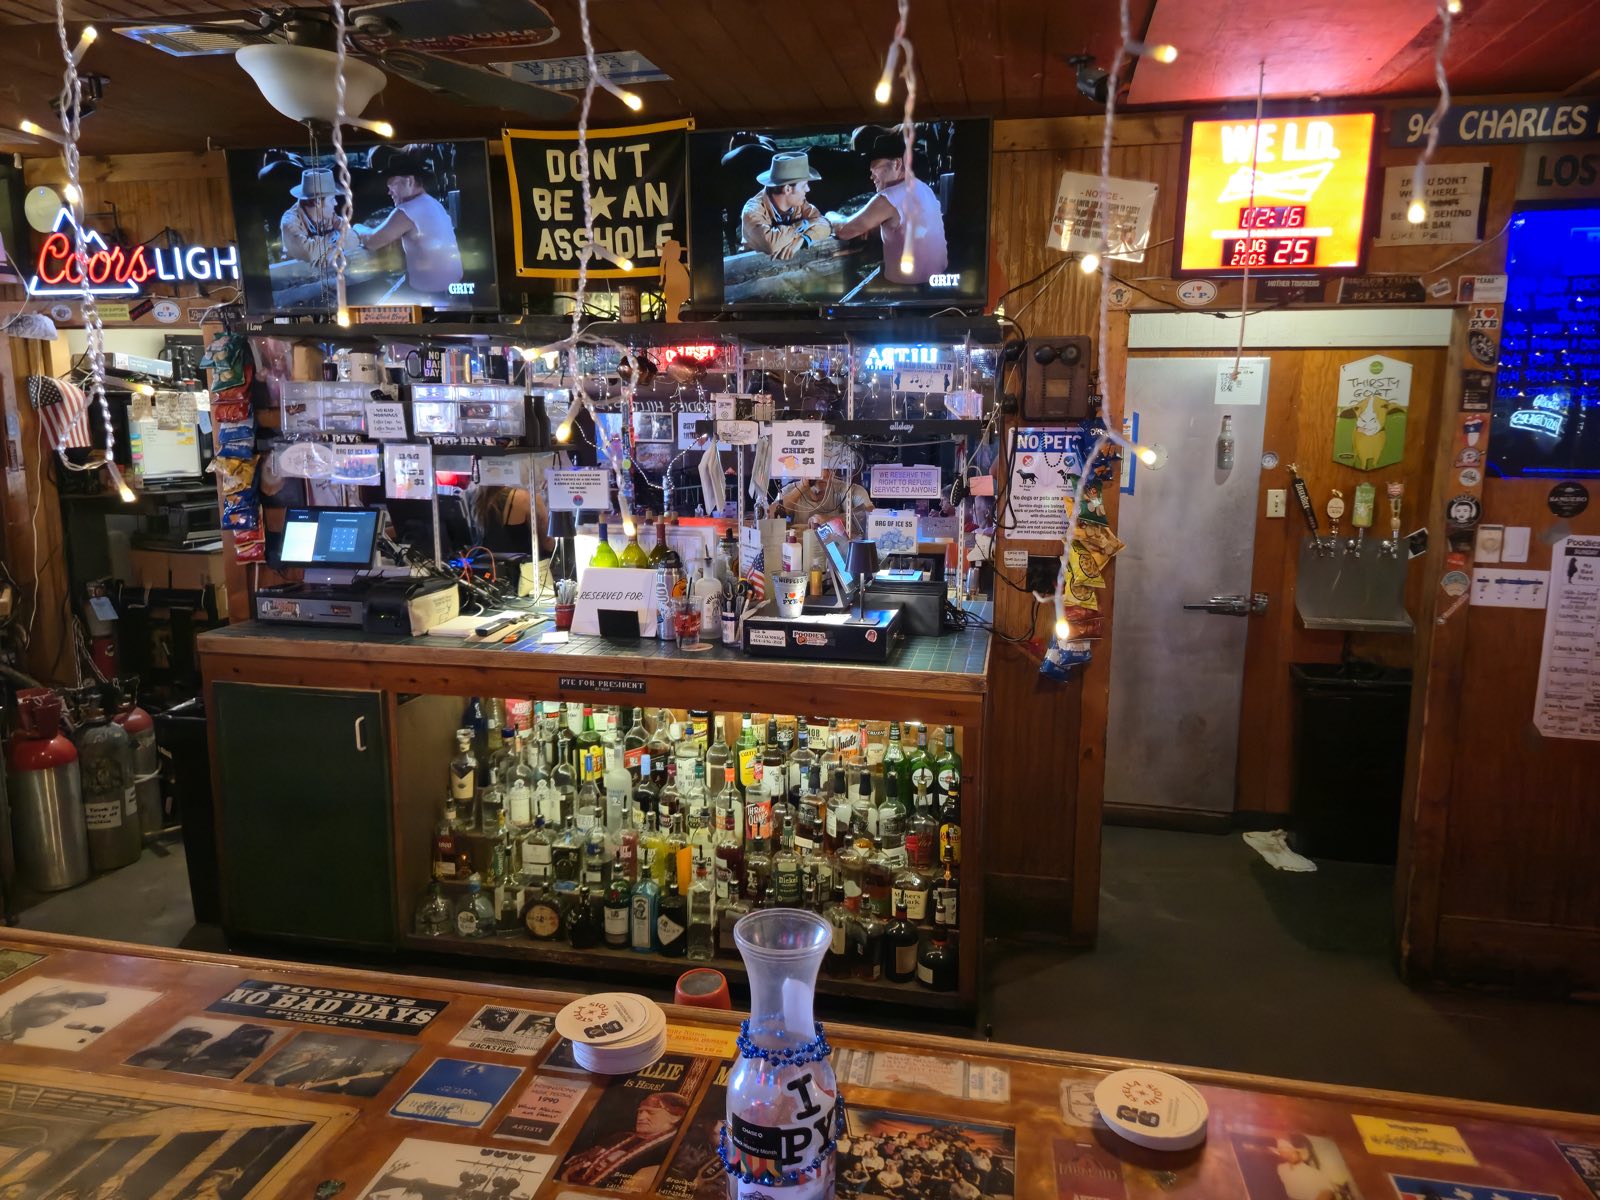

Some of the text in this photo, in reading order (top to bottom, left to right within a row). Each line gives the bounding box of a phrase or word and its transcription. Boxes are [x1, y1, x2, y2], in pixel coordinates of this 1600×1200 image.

[1459, 104, 1589, 141] CHARLES
[1220, 123, 1277, 164] WE
[545, 143, 650, 184] DON'T
[532, 182, 669, 221] BE AN
[1085, 190, 1118, 200] NOCE
[1241, 207, 1302, 228] 02:16
[536, 223, 675, 261] ASSHOLE
[1273, 239, 1310, 264] 25
[38, 233, 239, 284] Coors LIGH
[929, 274, 960, 288] GRIT
[448, 282, 475, 295] GRIT
[1470, 320, 1498, 329] PYE
[428, 351, 440, 360] NO
[424, 369, 440, 377] DAY
[1347, 377, 1400, 389] THIRSTY
[1353, 388, 1391, 399] GOAT
[889, 422, 914, 433] allday
[1016, 434, 1039, 450] NO
[802, 457, 815, 466] $1
[879, 471, 889, 479] WE
[873, 486, 937, 494] SERVICE TO ANYONE
[579, 590, 644, 601] RESERVED FOR:
[561, 678, 576, 686] PYE
[578, 679, 595, 687] FOR
[598, 680, 645, 689] PRESIDENT
[268, 983, 418, 1007] POODIE'S
[220, 988, 438, 1026] NO BAD DAYS
[285, 1015, 339, 1025] TEXAS
[468, 1041, 518, 1054] BACKSTAGE
[637, 1062, 684, 1081] LLIE
[787, 1073, 822, 1121] I
[779, 1107, 836, 1166] PY
[760, 1147, 778, 1156] Month
